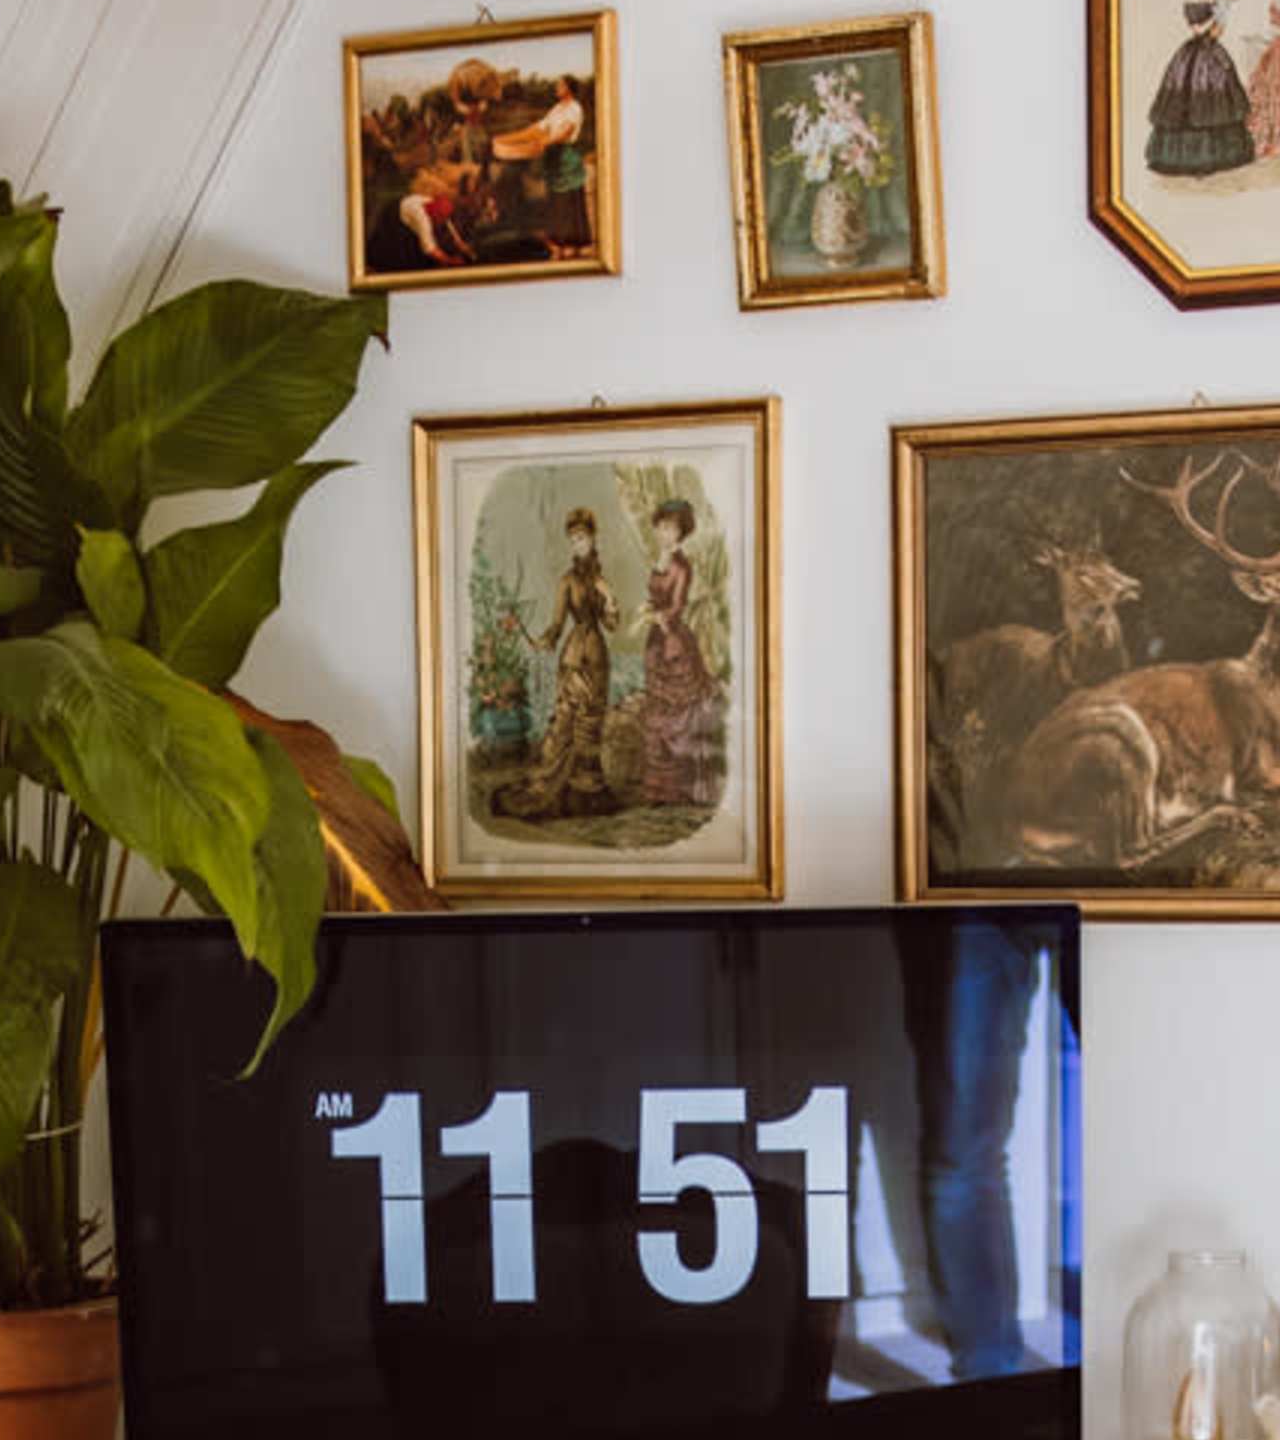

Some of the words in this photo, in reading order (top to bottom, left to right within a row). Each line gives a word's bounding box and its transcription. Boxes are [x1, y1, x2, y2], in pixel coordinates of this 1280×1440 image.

[315, 1093, 353, 1118] AM
[330, 1092, 536, 1303] 11
[637, 1086, 851, 1303] 51
